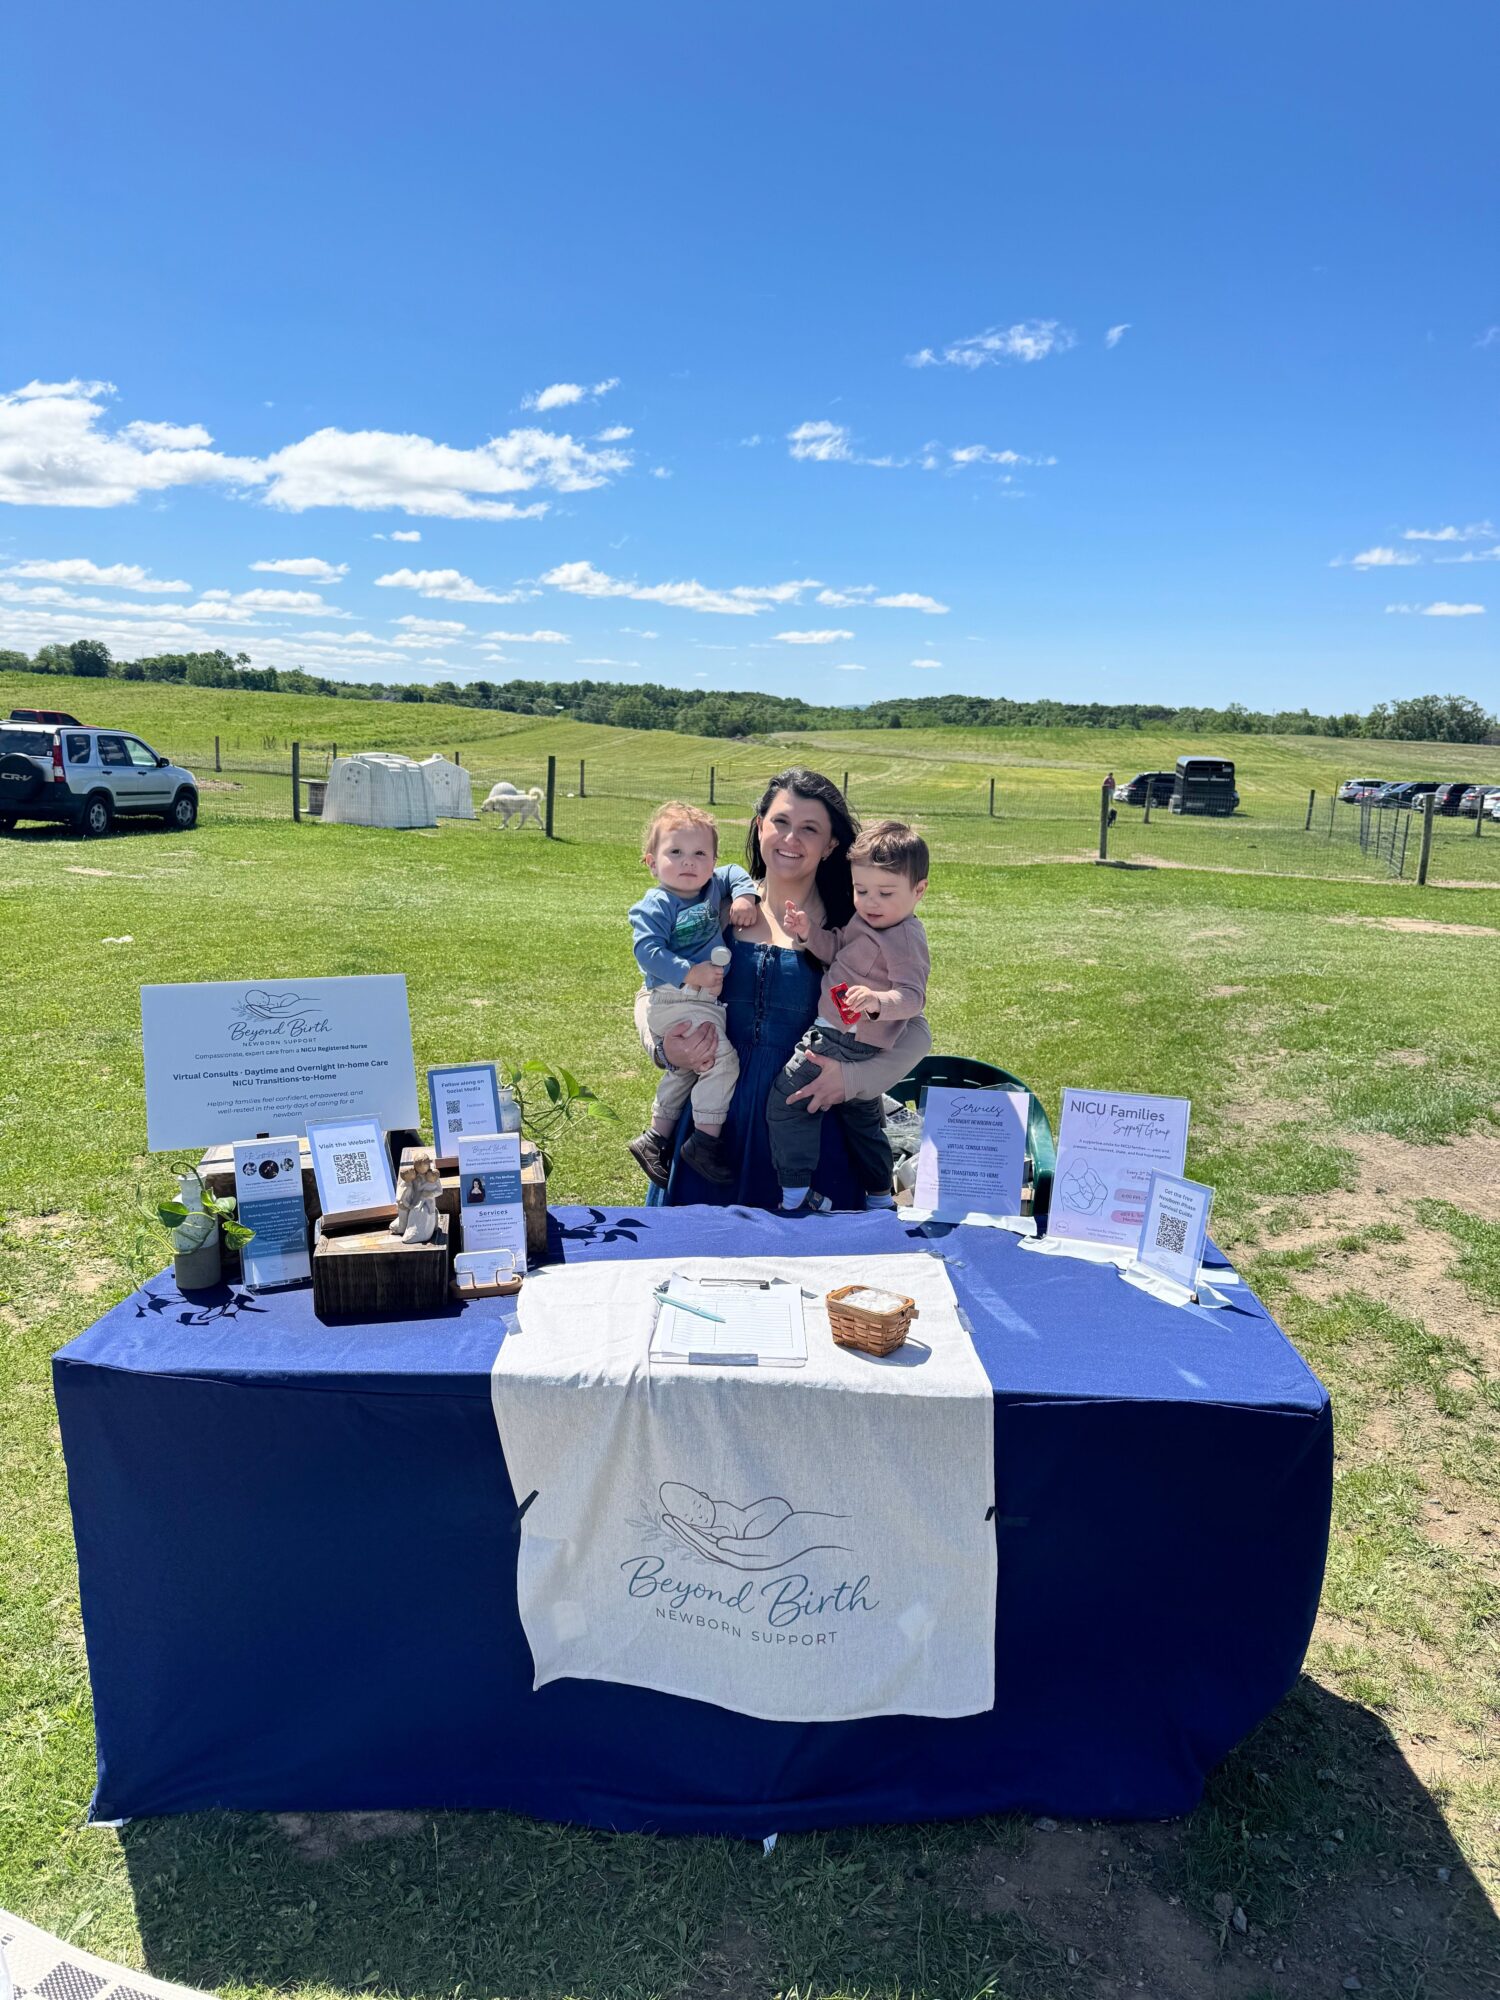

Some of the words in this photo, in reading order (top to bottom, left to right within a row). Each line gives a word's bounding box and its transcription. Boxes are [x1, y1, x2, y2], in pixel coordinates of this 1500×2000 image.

[1, 772, 33, 781] CR-V
[227, 1020, 286, 1042] Beyond
[286, 1018, 333, 1038] Birth
[242, 1039, 281, 1047] NEWBORN
[283, 1037, 317, 1045] SUPPORT
[194, 1050, 245, 1060] Compassionate,
[245, 1050, 265, 1058] expert
[317, 1044, 349, 1053] Registered
[172, 1072, 201, 1081] Virtual
[202, 1070, 239, 1079] Consults
[244, 1066, 279, 1077] Daytime
[279, 1065, 295, 1074] and
[296, 1062, 336, 1072] Overnight
[337, 1060, 370, 1070] In-home
[370, 1059, 389, 1067] Care
[232, 1079, 254, 1087] NICU
[255, 1073, 337, 1085] Transitions-to-Home
[207, 1099, 234, 1108] Helping
[234, 1098, 261, 1106] families
[262, 1095, 275, 1103] feel
[275, 1093, 309, 1102] confident,
[350, 1089, 364, 1097] and
[217, 1105, 255, 1115] well-rested
[255, 1104, 263, 1112] in
[263, 1103, 275, 1111] the
[275, 1102, 293, 1111] early
[293, 1101, 309, 1110] days
[310, 1100, 318, 1108] of
[317, 1098, 339, 1107] caring
[339, 1097, 349, 1105] for
[949, 1096, 1005, 1118] Services
[1070, 1100, 1107, 1116] NICU
[1110, 1104, 1166, 1122] Families
[1113, 1118, 1145, 1138] Support
[1144, 1121, 1171, 1142] Group
[347, 1138, 376, 1147] Website
[1158, 1194, 1181, 1206] Newborn
[1164, 1188, 1174, 1196] Get
[1182, 1195, 1194, 1203] free
[478, 1209, 509, 1217] Services
[1159, 1202, 1179, 1213] Survival
[1178, 1209, 1193, 1219] Guide
[620, 1555, 755, 1614] Beyond
[760, 1574, 880, 1628] Birth
[655, 1607, 742, 1638] NEWBORN
[750, 1630, 838, 1646] SUPPORT
